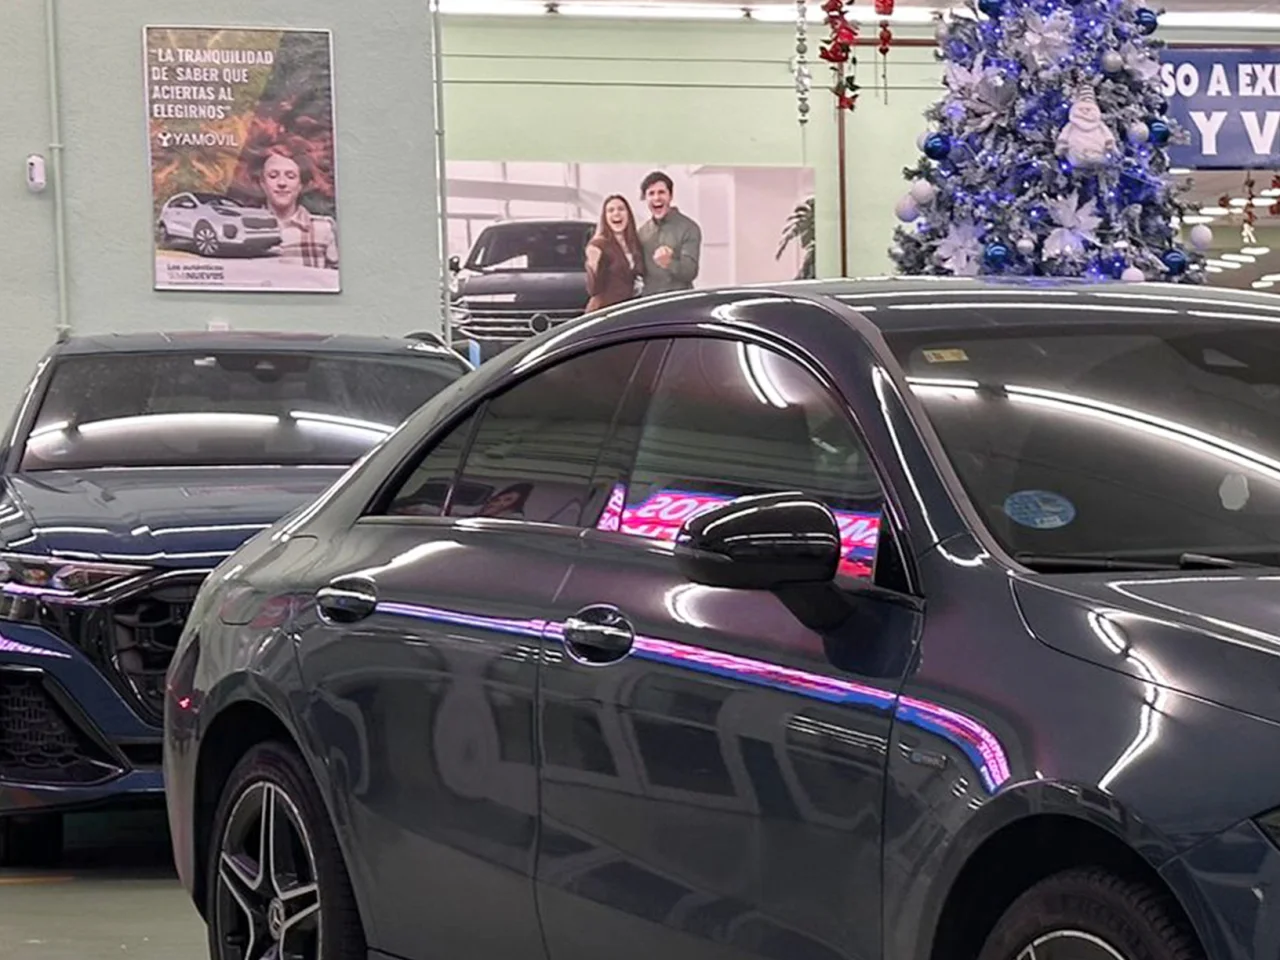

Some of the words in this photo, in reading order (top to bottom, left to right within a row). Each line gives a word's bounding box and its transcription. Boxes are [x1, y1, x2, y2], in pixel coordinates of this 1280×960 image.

[177, 48, 274, 65] TRANQUILIDAD
[151, 66, 169, 81] DE
[175, 67, 219, 82] SABER
[222, 68, 249, 84] QUE
[1160, 63, 1199, 97] SO
[1206, 63, 1231, 97] A
[152, 85, 215, 100] ACIERTAS
[218, 87, 235, 101] AL
[172, 132, 239, 147] YAMOVIL
[1189, 110, 1228, 155] Y
